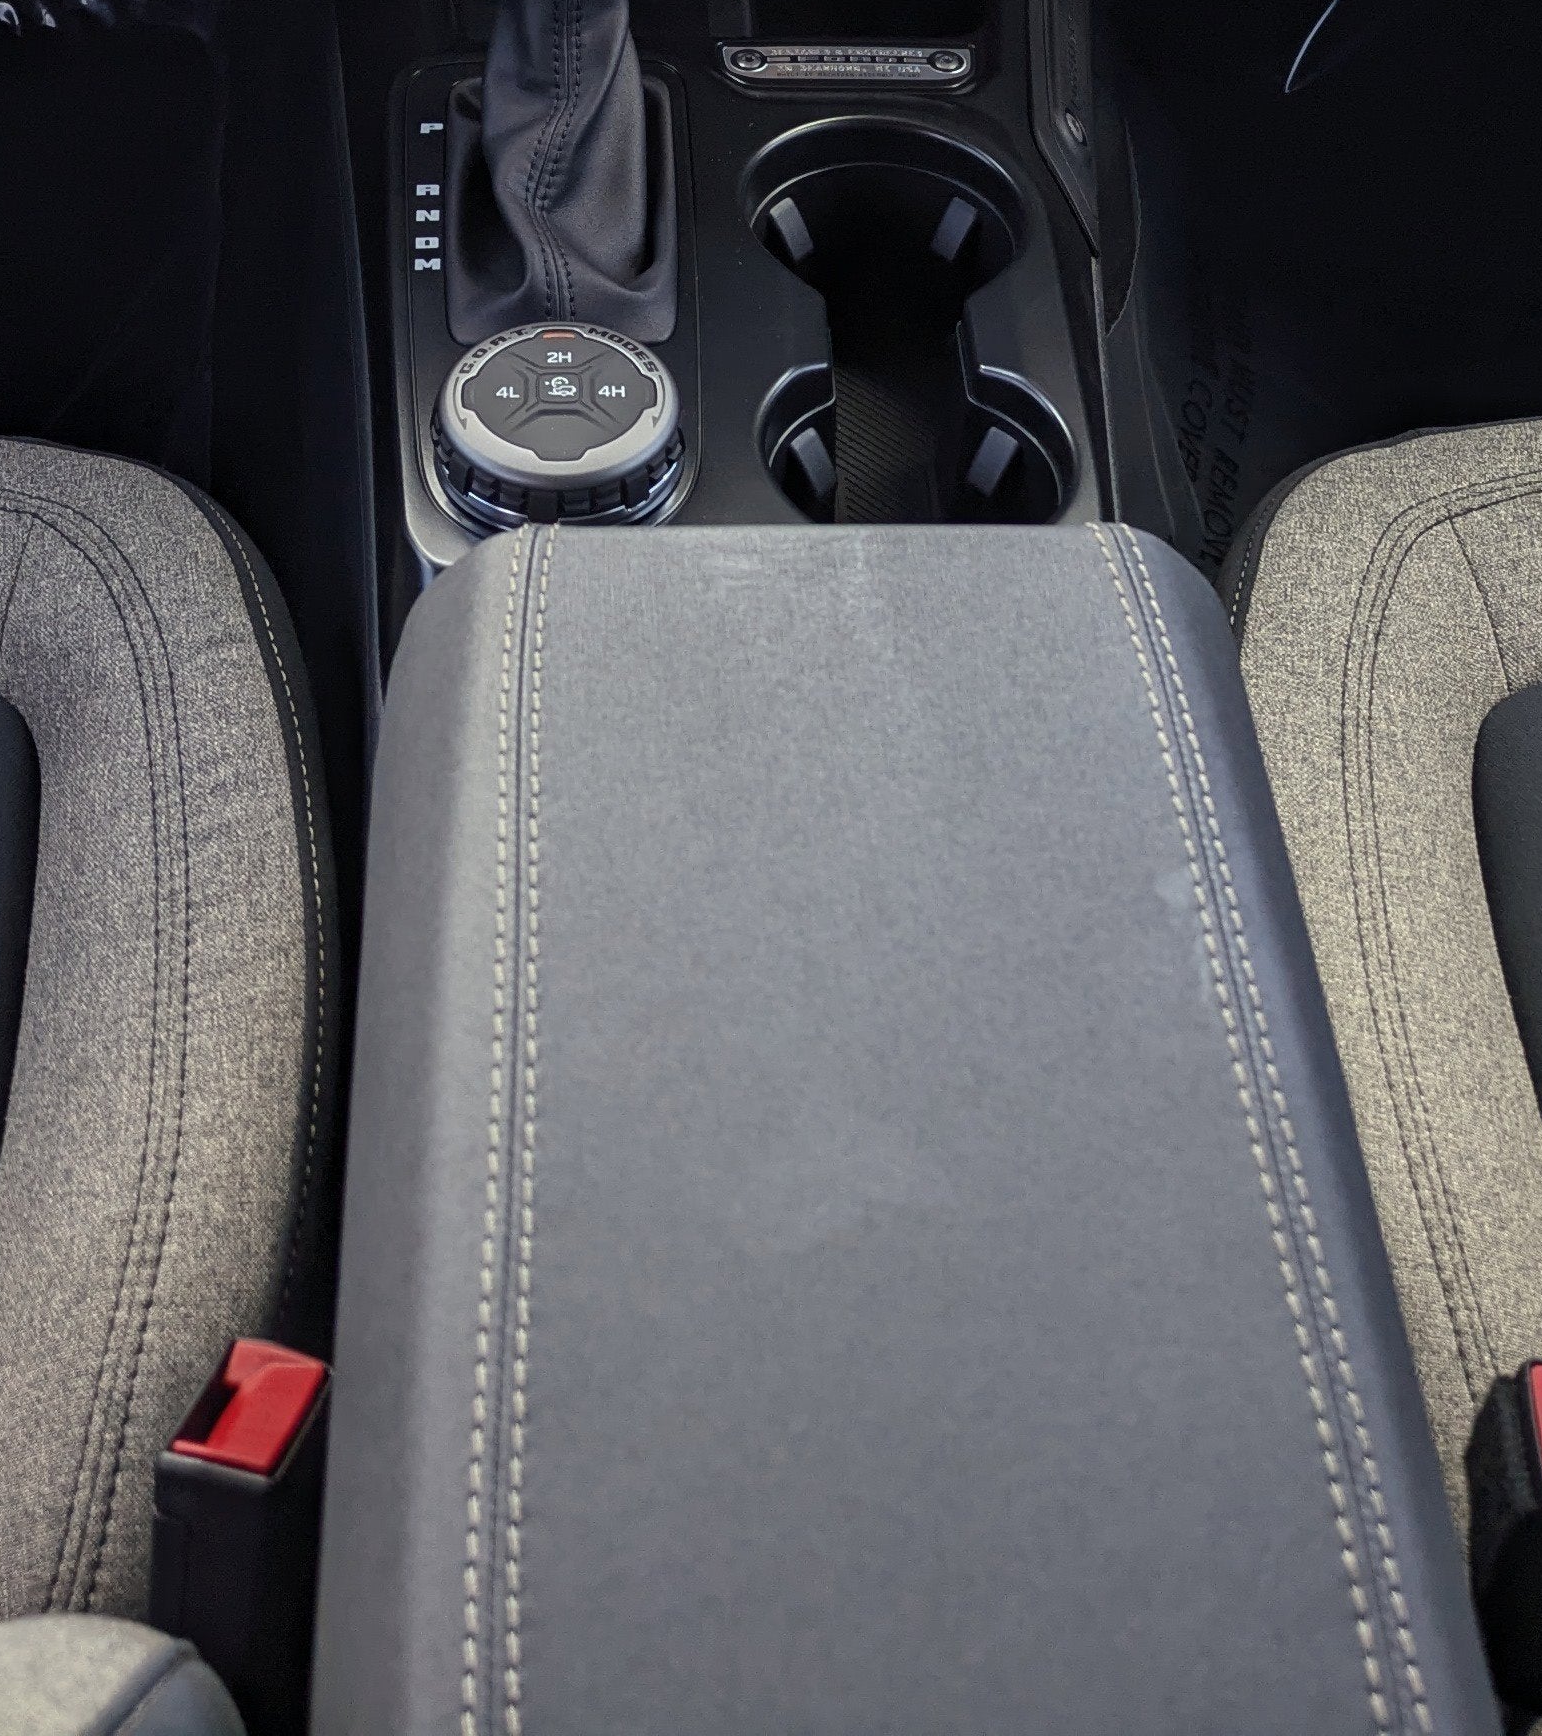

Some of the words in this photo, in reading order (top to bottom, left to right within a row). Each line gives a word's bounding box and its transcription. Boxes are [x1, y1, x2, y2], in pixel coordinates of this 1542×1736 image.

[419, 122, 444, 134] P
[416, 184, 440, 196] R
[415, 209, 440, 222] N
[415, 237, 439, 249] D
[414, 258, 441, 271] M
[588, 327, 659, 373] MODES
[547, 351, 572, 363] 2H
[496, 386, 520, 398] 4L
[598, 385, 625, 397] 4H
